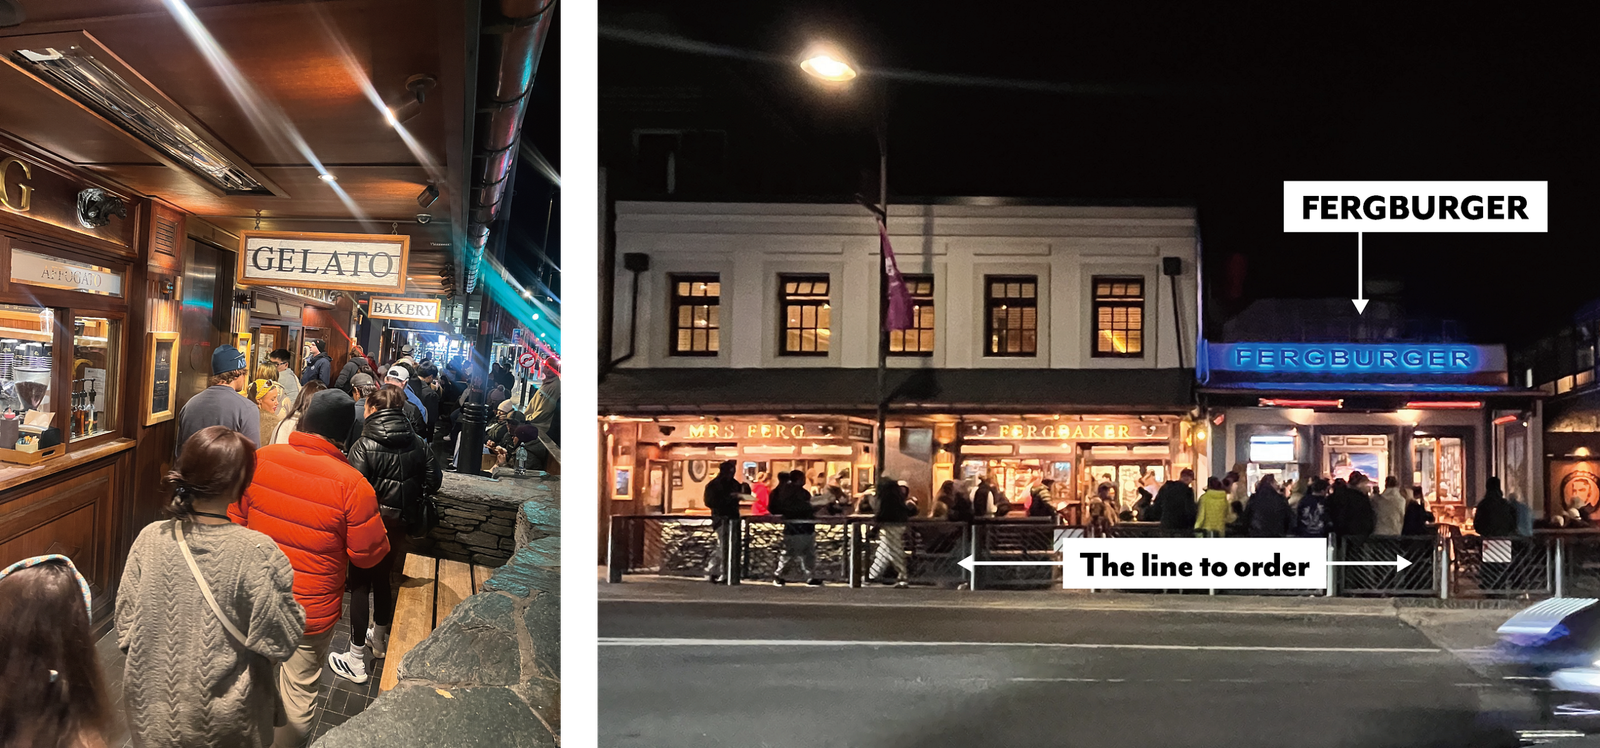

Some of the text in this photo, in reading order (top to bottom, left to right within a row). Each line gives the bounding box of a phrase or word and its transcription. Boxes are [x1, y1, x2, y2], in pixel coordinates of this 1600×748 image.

[252, 245, 394, 278] GELATO
[41, 265, 102, 288] AFFOGATO
[374, 302, 435, 316] BAKERY
[1236, 348, 1472, 367] FERGBURGER
[689, 424, 805, 438] MRS FERG
[999, 424, 1131, 439] FERGBAKER
